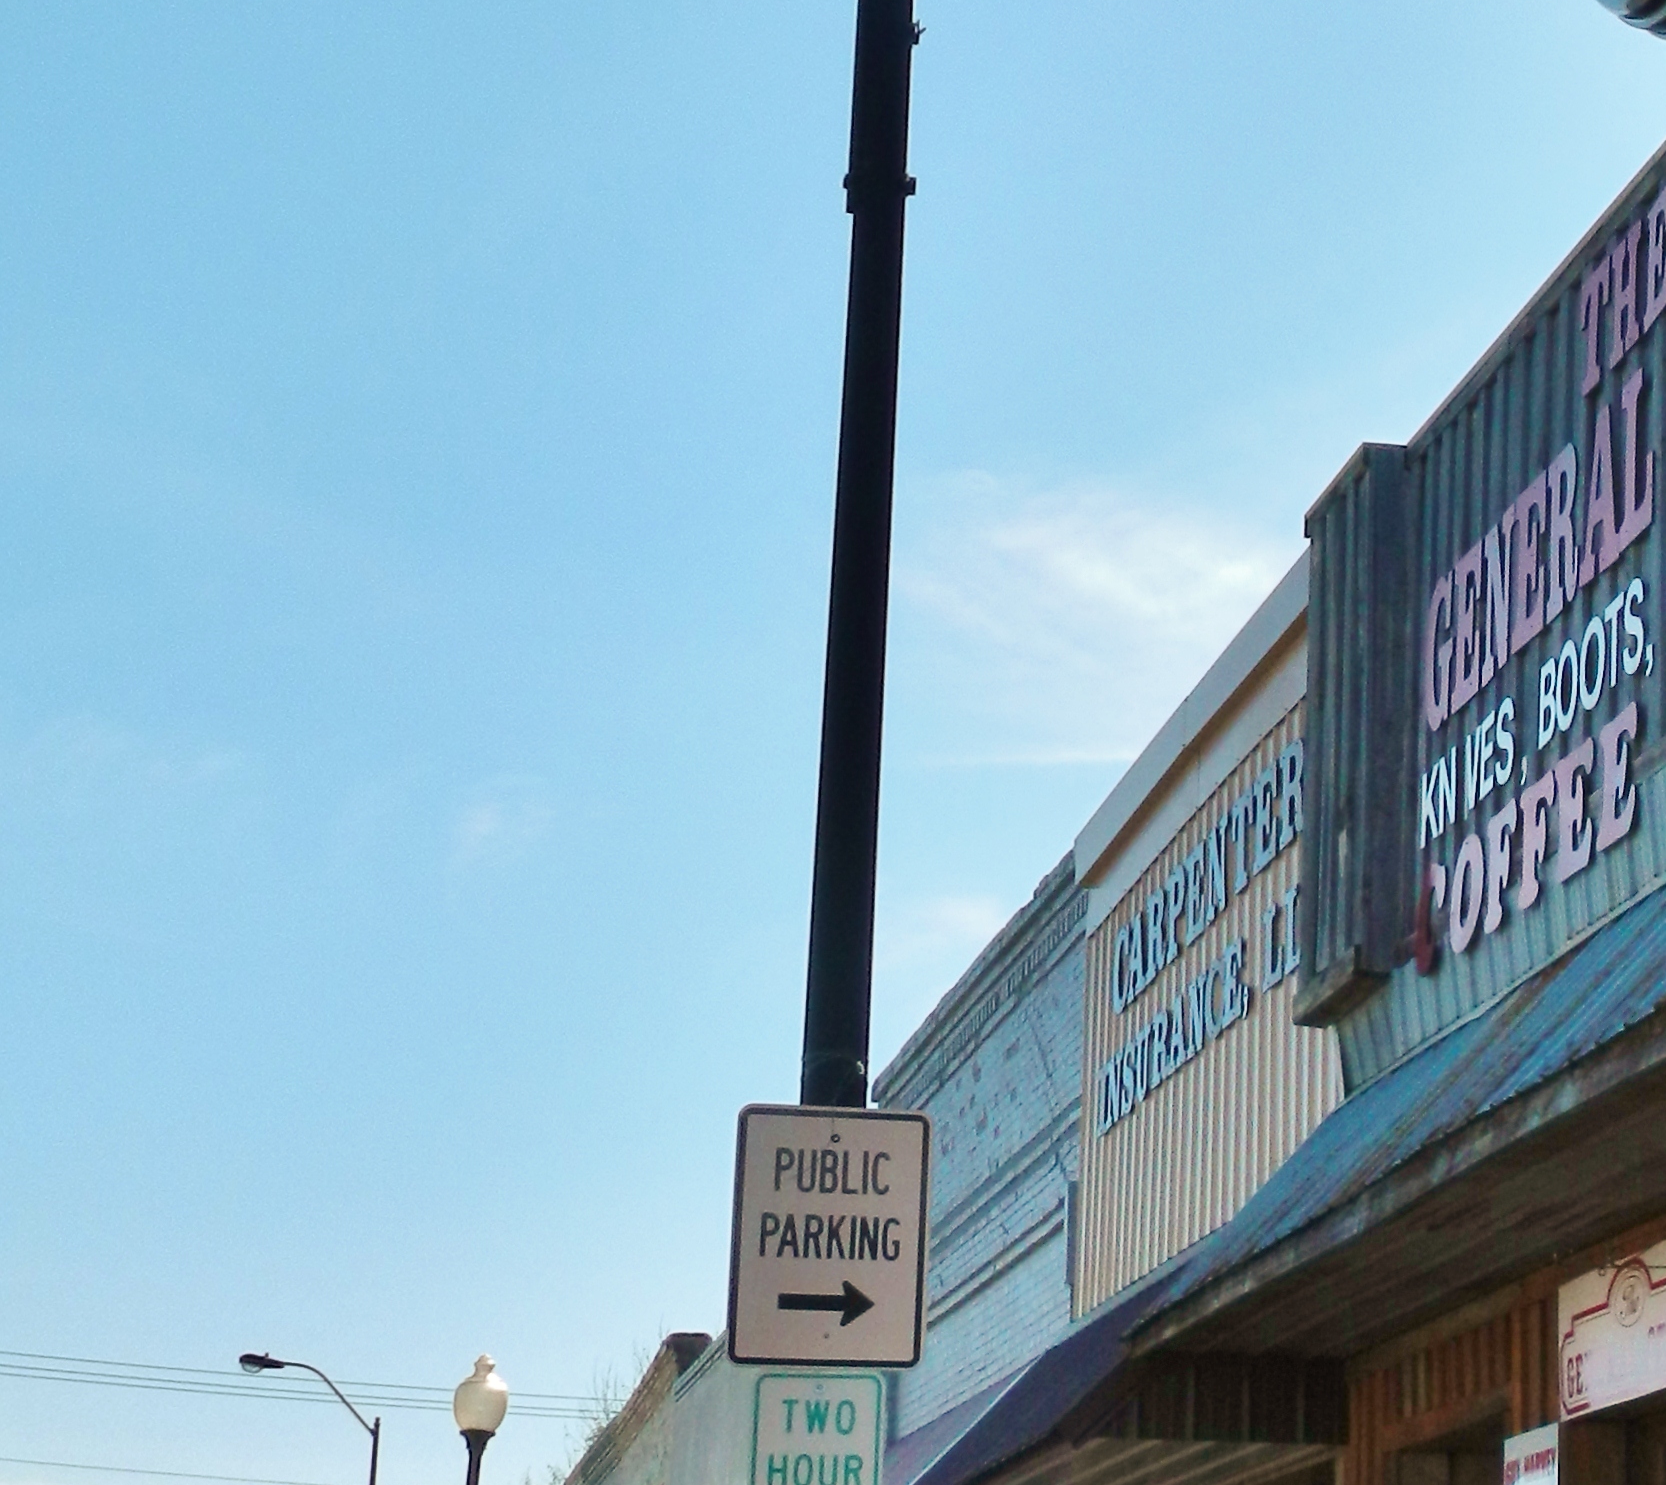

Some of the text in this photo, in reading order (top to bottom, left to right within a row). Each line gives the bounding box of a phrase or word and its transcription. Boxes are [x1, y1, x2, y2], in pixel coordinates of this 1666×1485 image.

[1423, 366, 1656, 732] GENERAL
[1537, 577, 1654, 751] BOOTS,
[1111, 738, 1304, 1015] CARPENTER
[1097, 936, 1250, 1138] INSURANCE,
[758, 1212, 902, 1261] PARKING
[774, 1146, 892, 1196] PUBLIC
[782, 1398, 857, 1436] TWO
